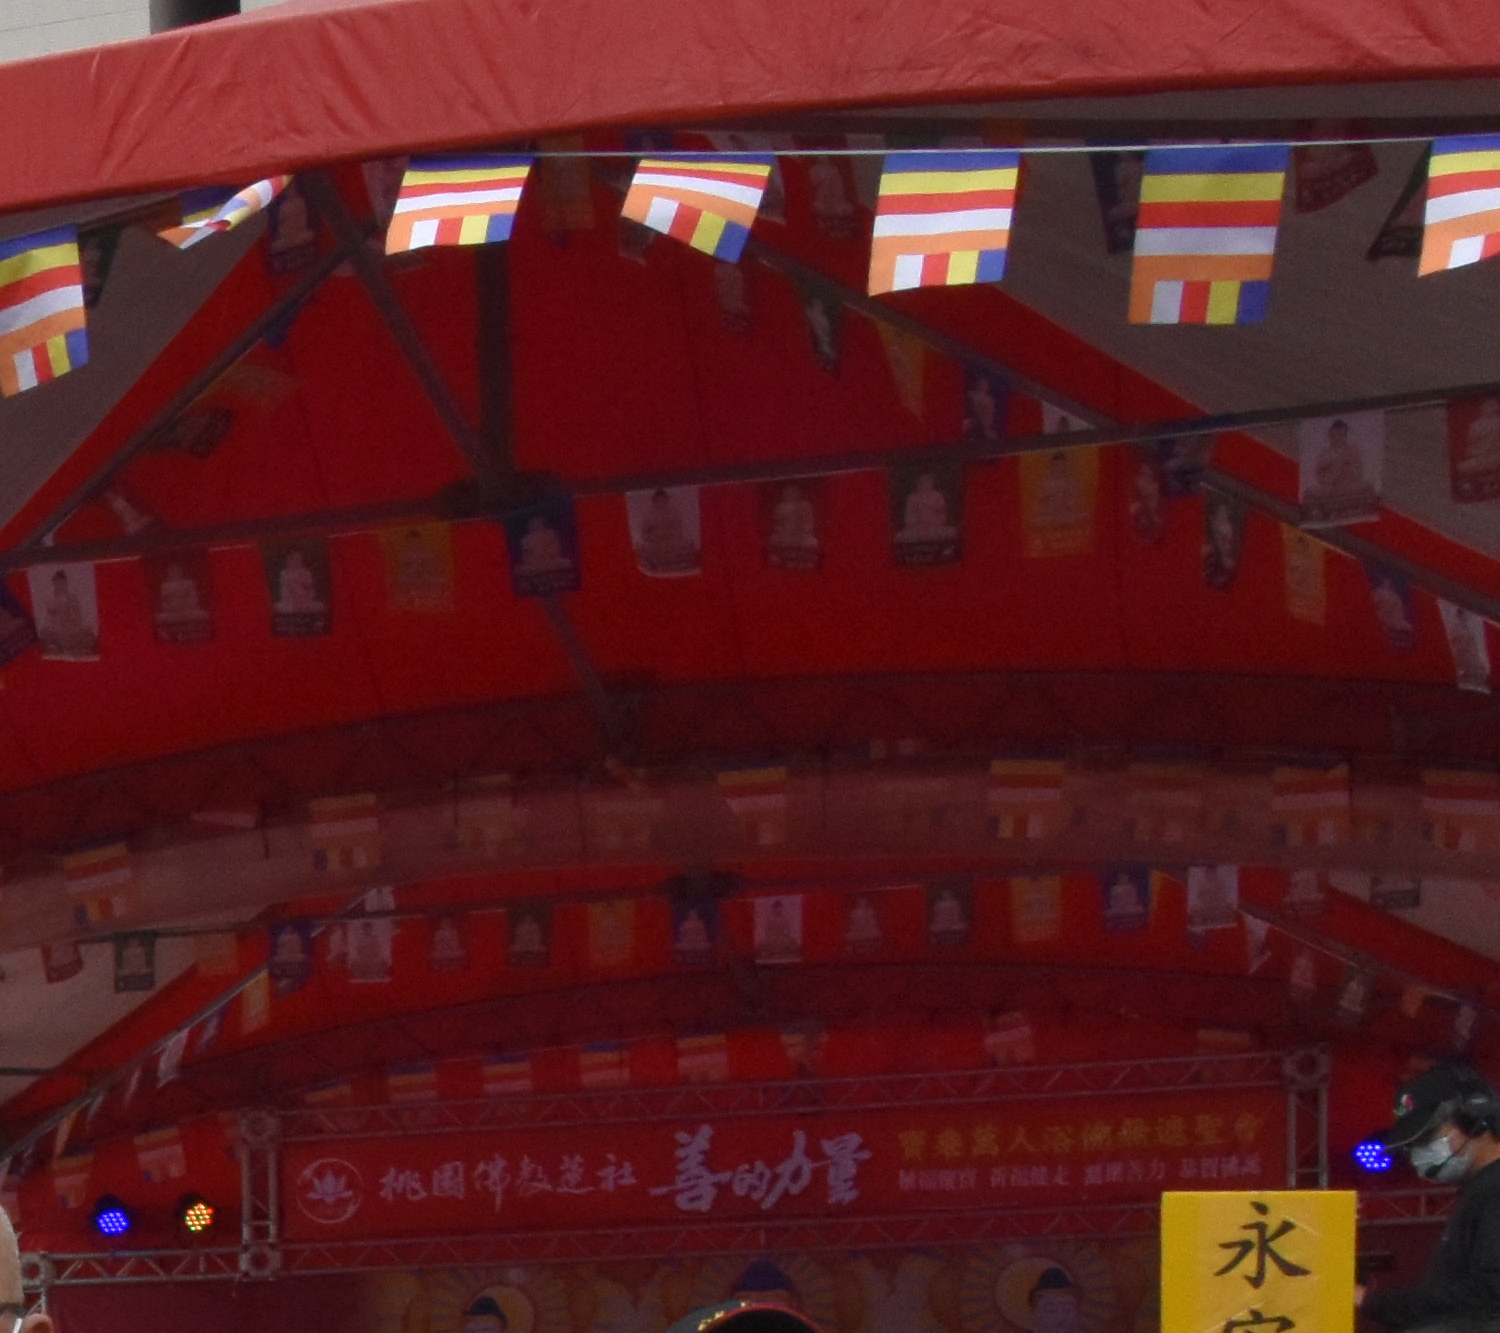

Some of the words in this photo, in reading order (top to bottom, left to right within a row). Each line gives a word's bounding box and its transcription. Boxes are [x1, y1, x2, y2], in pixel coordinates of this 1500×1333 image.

[379, 1153, 636, 1212] 桃園佛教蓮社
[649, 1125, 871, 1211] 善的力量
